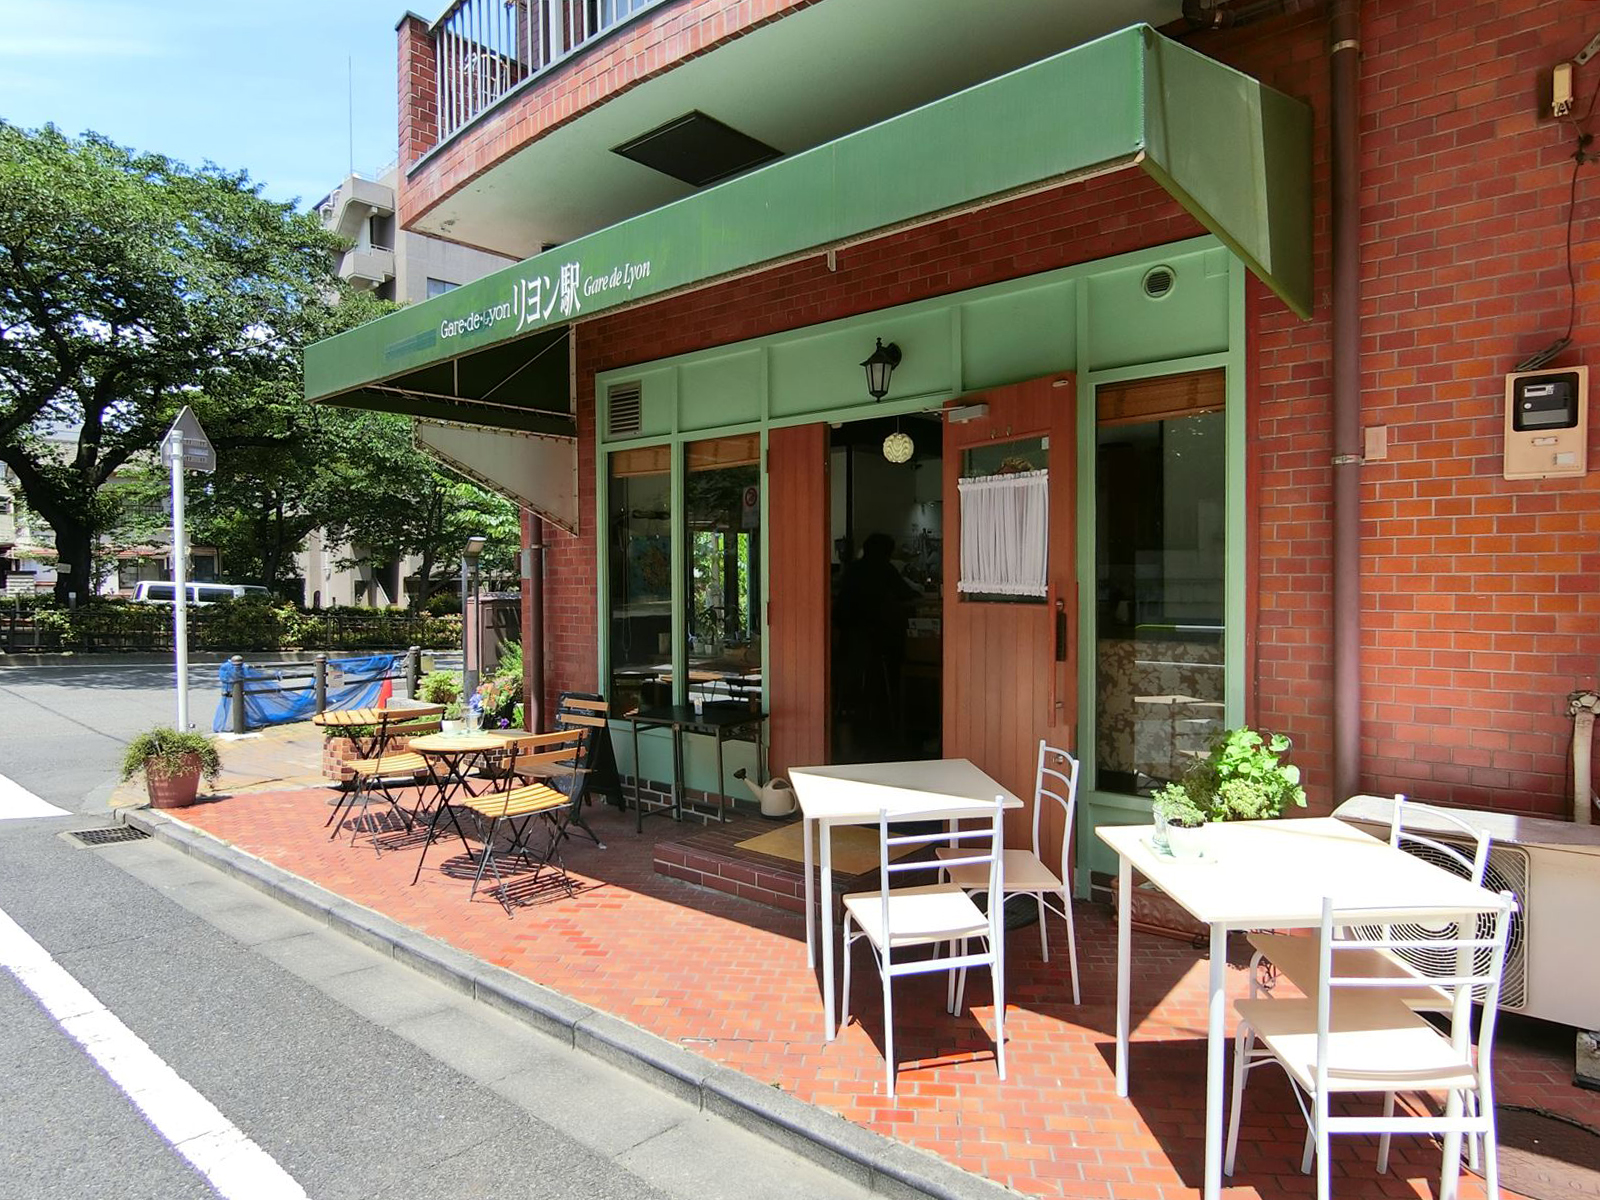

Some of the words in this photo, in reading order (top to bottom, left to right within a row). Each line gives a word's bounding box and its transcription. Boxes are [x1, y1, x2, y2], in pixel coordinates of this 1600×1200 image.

[513, 261, 581, 332] リヨン駅
[584, 275, 609, 296] Gare
[609, 266, 622, 288] de
[623, 261, 650, 290] Lyon
